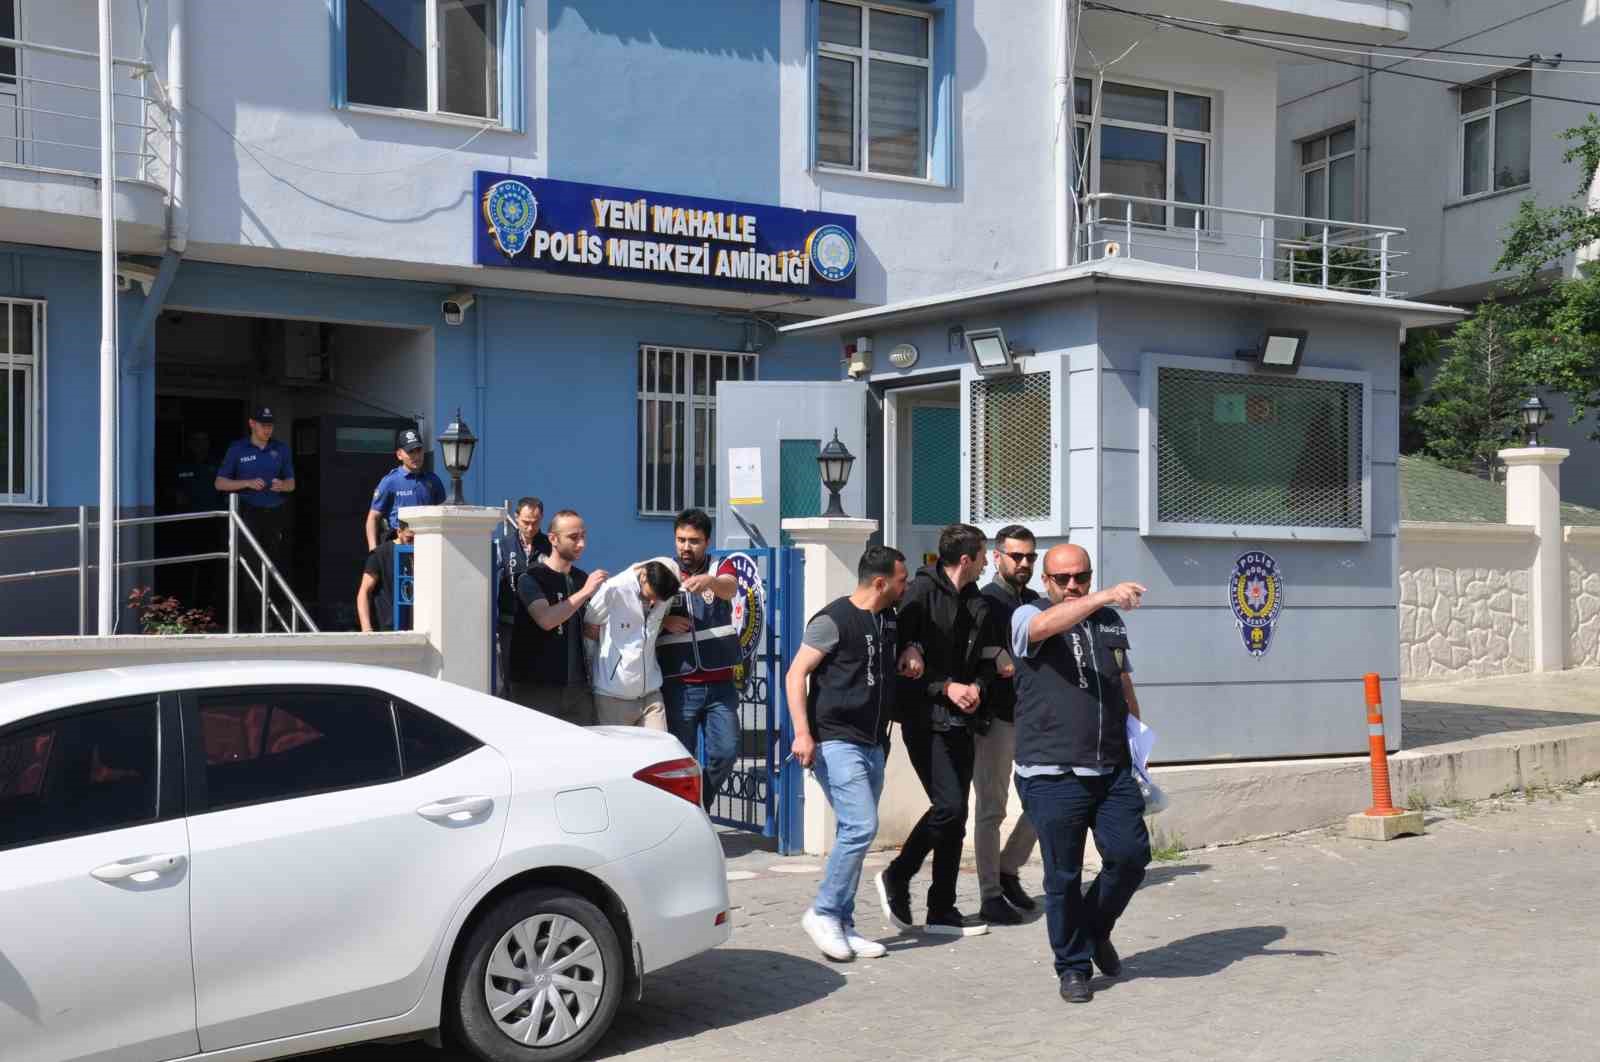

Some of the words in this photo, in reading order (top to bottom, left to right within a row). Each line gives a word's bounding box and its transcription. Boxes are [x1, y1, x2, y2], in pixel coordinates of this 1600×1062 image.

[592, 198, 647, 231] YENİ
[652, 204, 757, 243] MAHALLE
[533, 230, 603, 264] POLİS
[606, 238, 709, 275] MERKEZİ
[714, 248, 810, 285] AMİRLİĞİ
